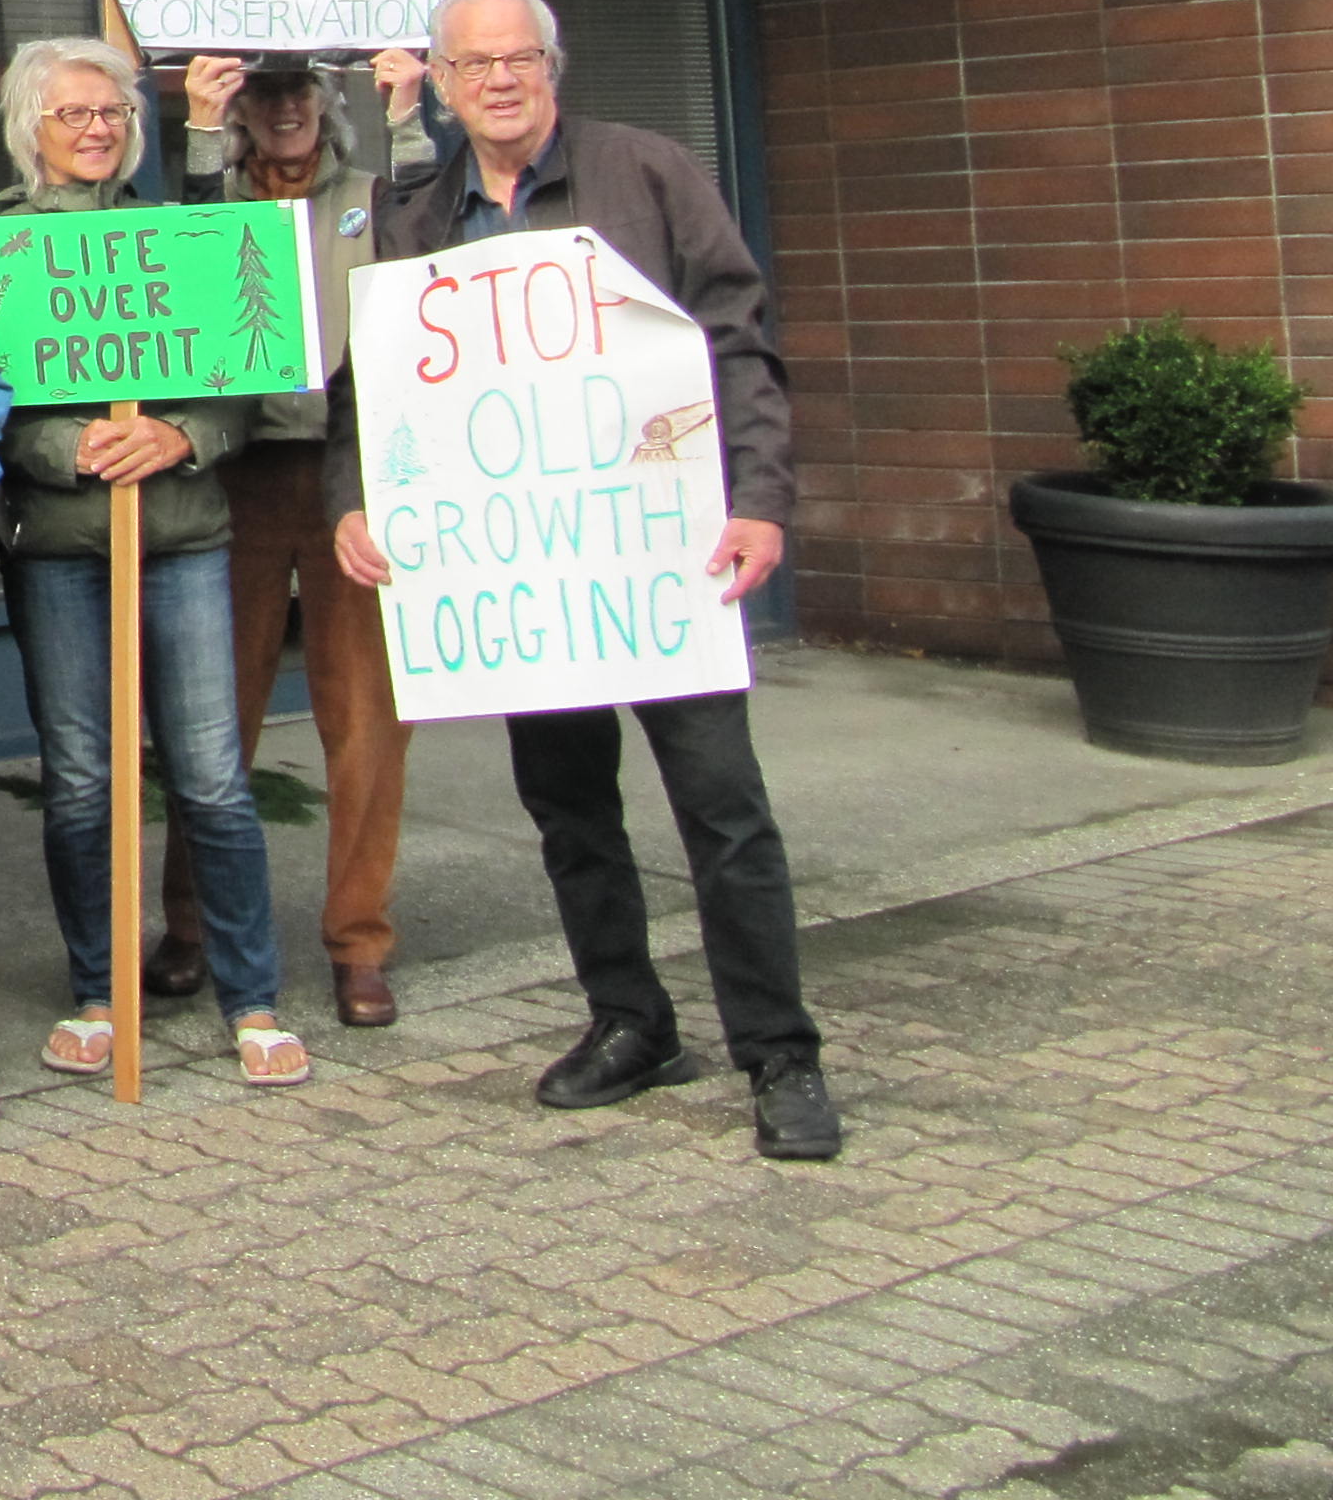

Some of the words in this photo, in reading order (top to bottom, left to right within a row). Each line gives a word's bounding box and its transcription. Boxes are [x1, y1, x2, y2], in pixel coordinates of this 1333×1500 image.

[44, 228, 167, 279] LIFE
[50, 281, 173, 323] OVER
[416, 254, 631, 384] STOP
[35, 327, 201, 385] PROFIT
[467, 374, 628, 480] OLD
[383, 478, 689, 572] GROWTH
[396, 571, 693, 675] LOGGING
